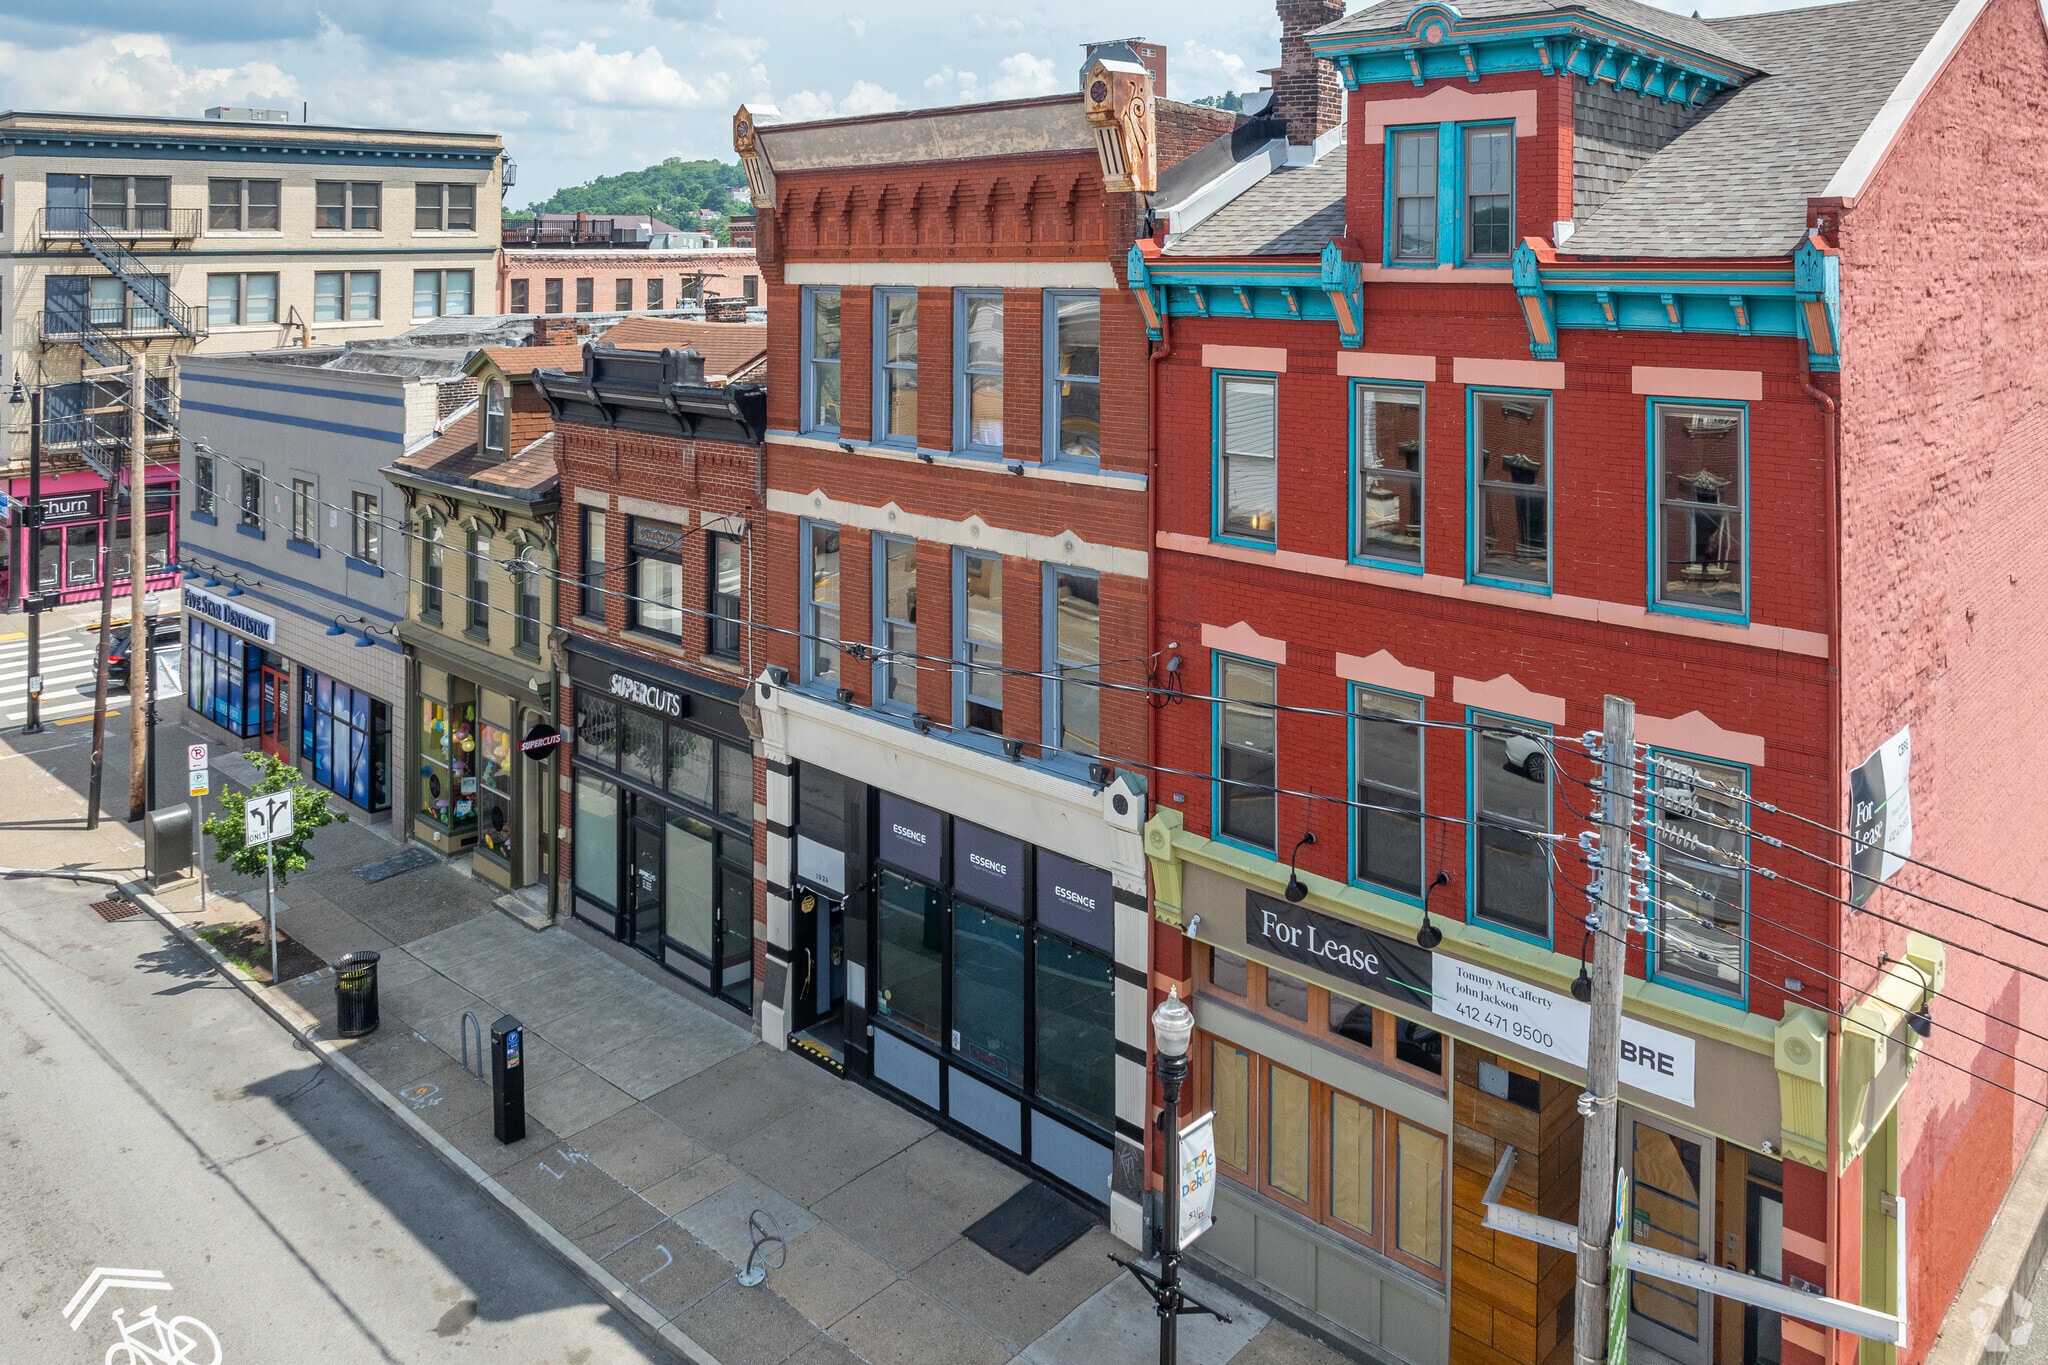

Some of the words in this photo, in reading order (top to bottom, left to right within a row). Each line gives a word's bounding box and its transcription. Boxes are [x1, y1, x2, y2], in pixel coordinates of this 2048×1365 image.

[184, 588, 201, 611] FIVE
[201, 595, 222, 620] STAR
[222, 604, 271, 640] DENTISTRY
[610, 673, 680, 716] SUPERCUTS
[521, 734, 561, 750] SUPERCUTS
[1855, 800, 1874, 828] For
[249, 830, 267, 843] ONLY
[893, 824, 926, 844] ESSENCE
[1854, 820, 1883, 855] Lease
[970, 853, 1007, 875] ESSENCE
[1055, 885, 1096, 910] ESSENCE
[1261, 909, 1302, 947] For
[1306, 925, 1379, 975] Lease
[1455, 982, 1478, 998] John
[1479, 991, 1519, 1012] Jackson
[1456, 966, 1494, 989] Tommy
[1496, 980, 1554, 1010] McCafferty
[1456, 1002, 1480, 1022] 412
[1484, 1012, 1508, 1033] 471
[1512, 1021, 1553, 1048] 9500
[1620, 1039, 1674, 1077] BRE
